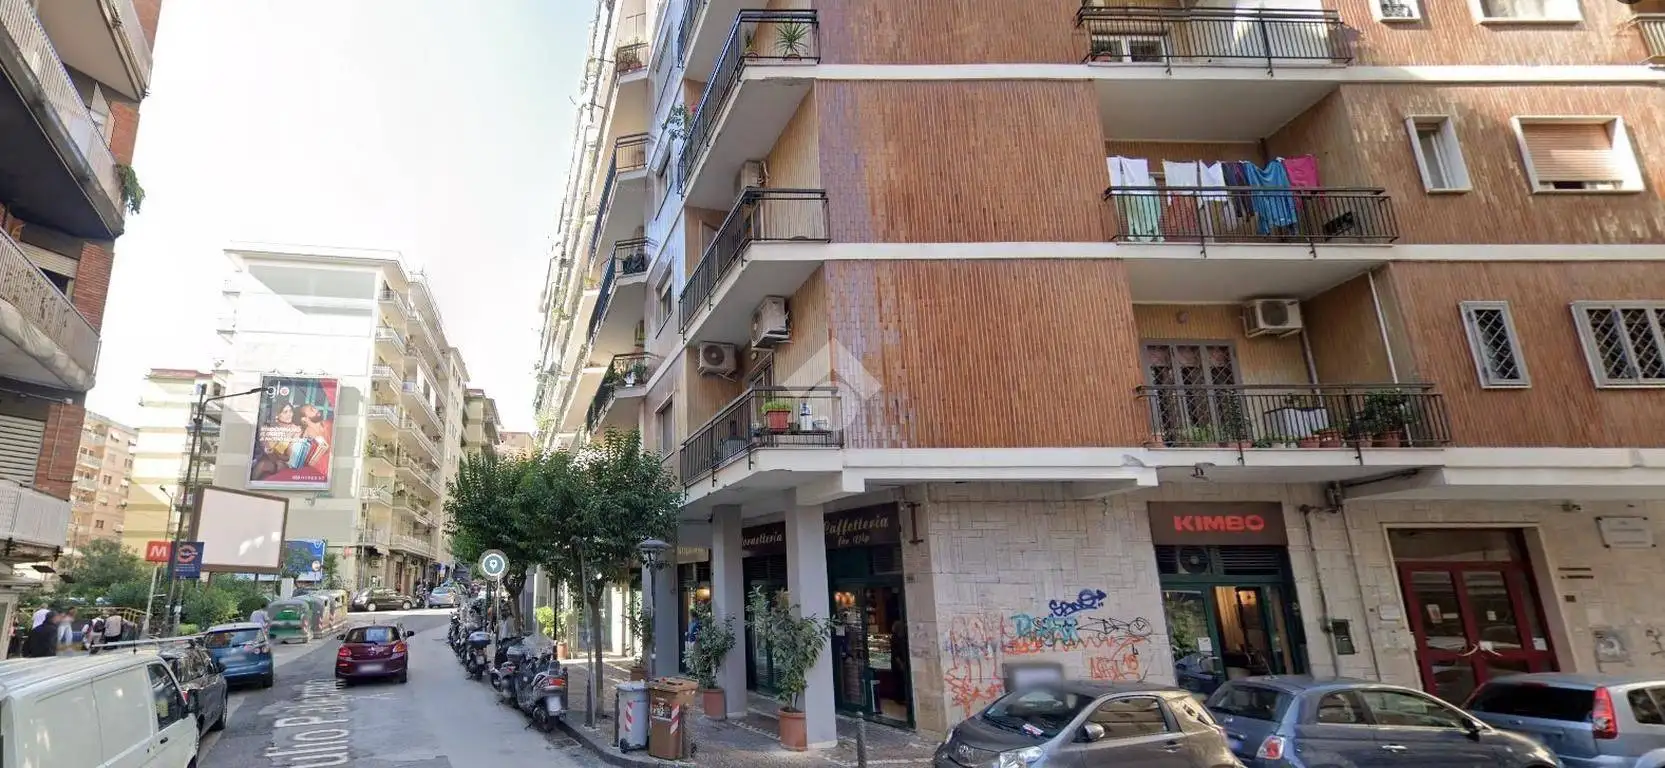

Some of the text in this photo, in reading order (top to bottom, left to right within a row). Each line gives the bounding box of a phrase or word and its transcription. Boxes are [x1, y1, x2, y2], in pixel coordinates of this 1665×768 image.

[1173, 514, 1265, 532] KIMBO
[742, 531, 783, 546] ornetteria
[150, 545, 167, 557] M
